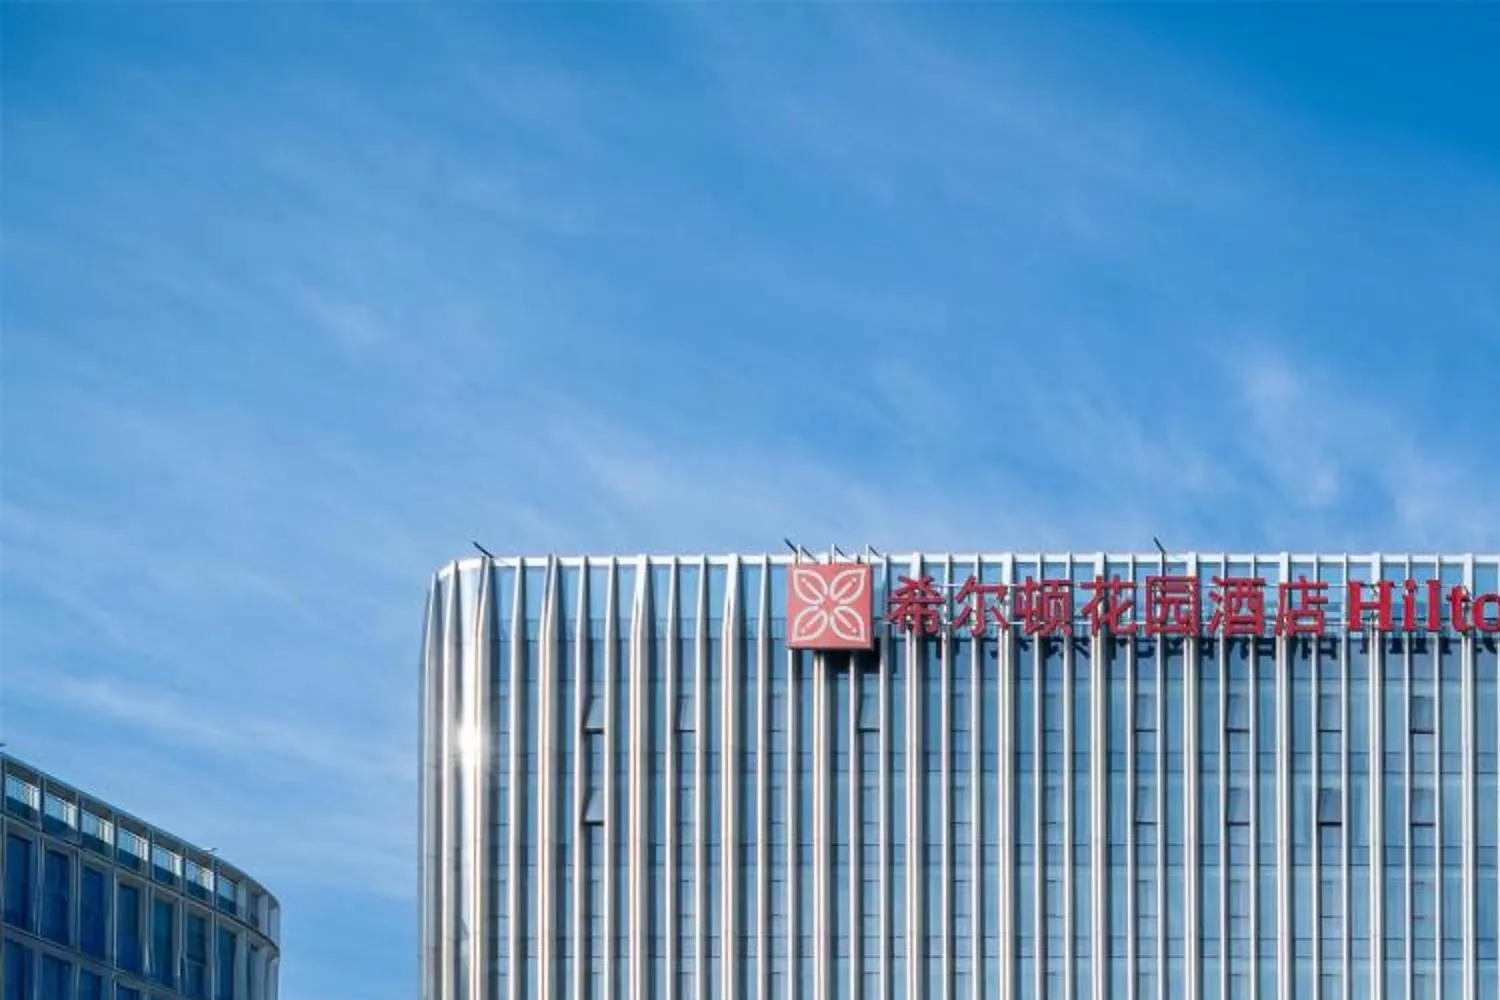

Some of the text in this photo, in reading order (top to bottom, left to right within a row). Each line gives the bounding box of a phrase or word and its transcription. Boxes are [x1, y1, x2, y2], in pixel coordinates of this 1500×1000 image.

[888, 576, 1328, 636] 希尔顿花园酒店
